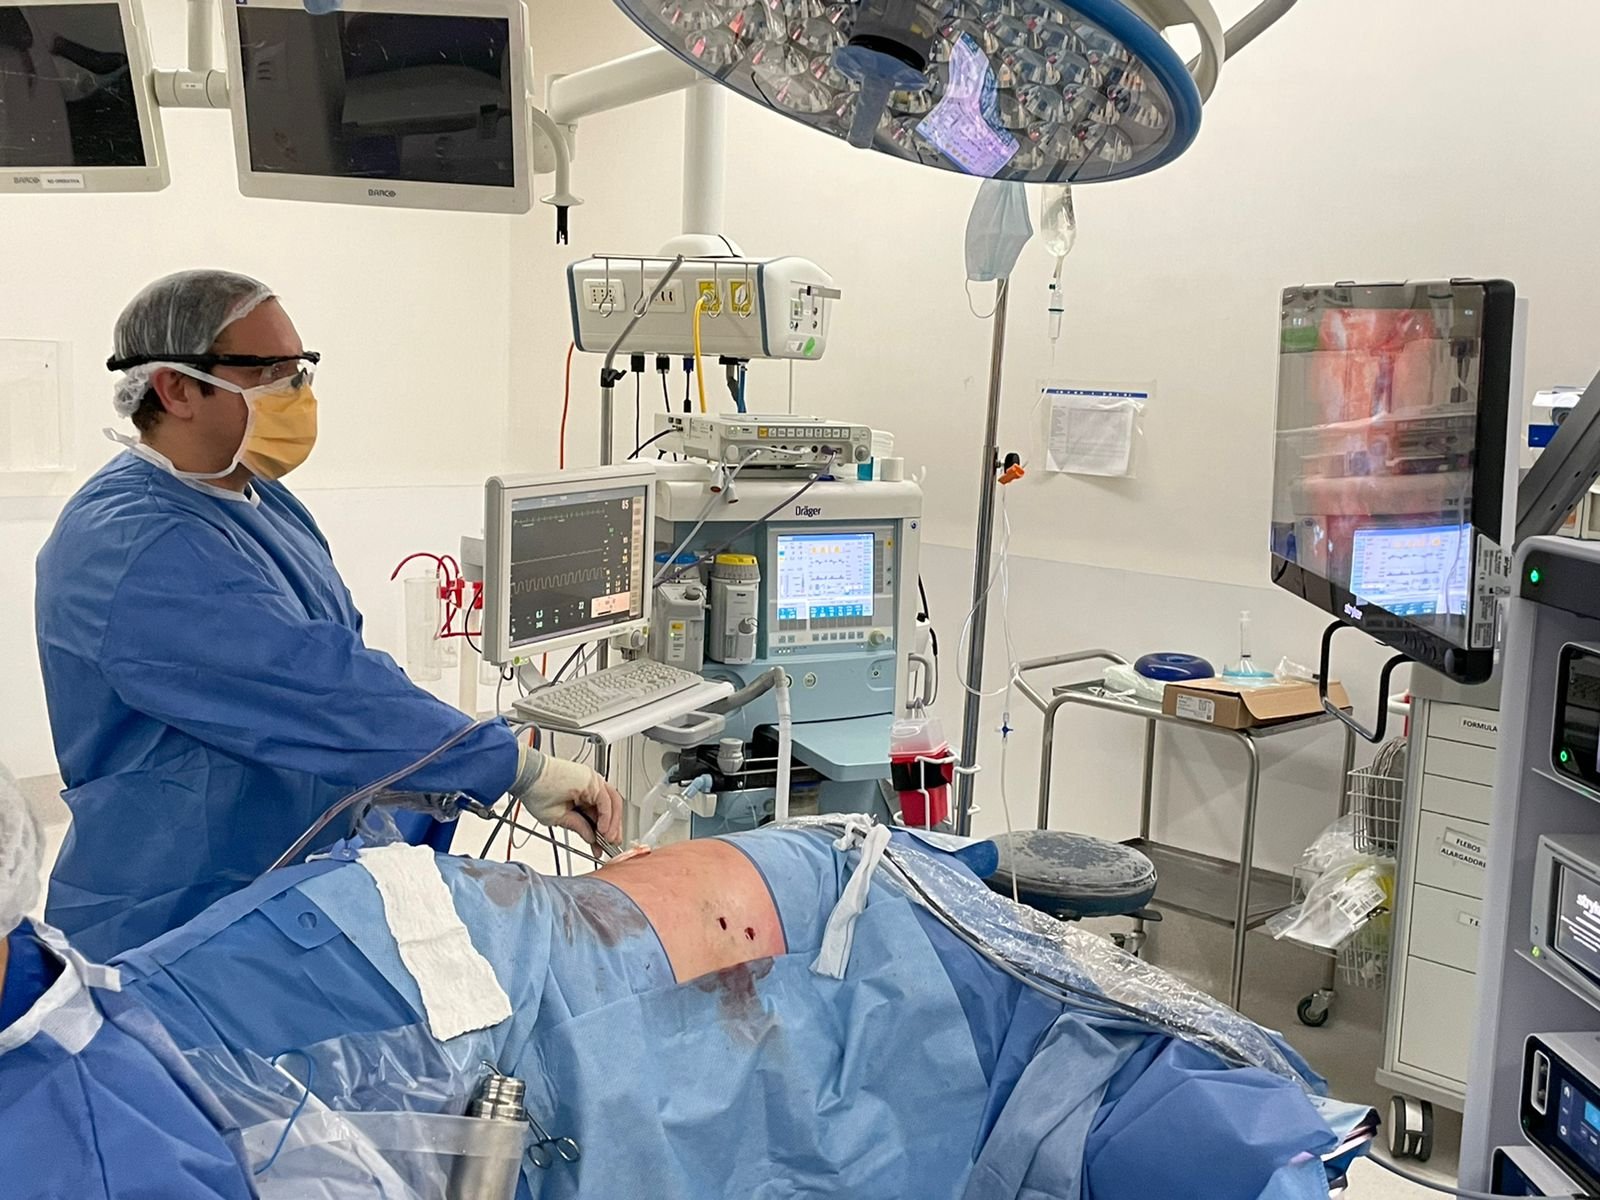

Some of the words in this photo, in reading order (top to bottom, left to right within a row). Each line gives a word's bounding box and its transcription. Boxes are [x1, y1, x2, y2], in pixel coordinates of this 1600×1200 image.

[368, 189, 397, 198] BARCO
[795, 505, 822, 518] Dräger
[1344, 602, 1364, 620] stryker
[1463, 719, 1498, 732] FORMULA
[1456, 838, 1481, 853] FLEBOS
